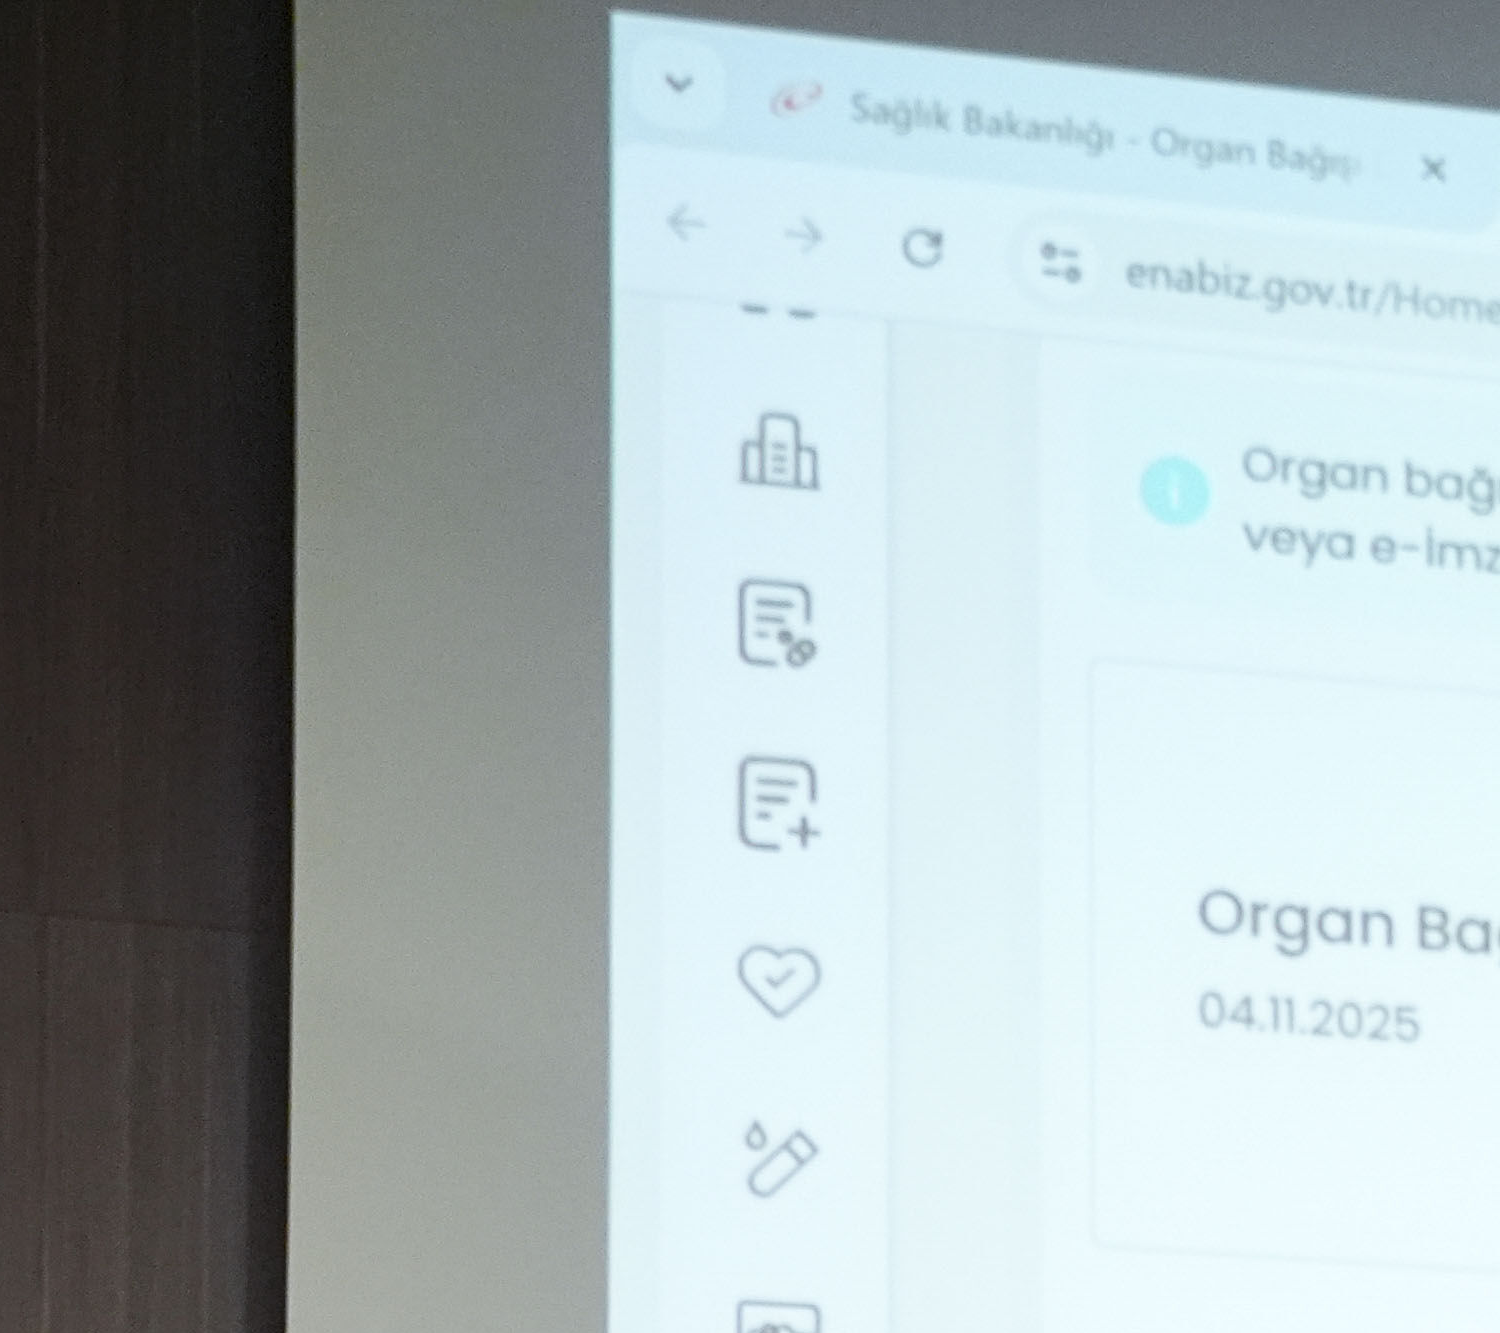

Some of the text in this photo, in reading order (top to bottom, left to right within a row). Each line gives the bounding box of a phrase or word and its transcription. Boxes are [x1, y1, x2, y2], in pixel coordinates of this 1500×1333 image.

[1151, 128, 1257, 170] Organ
[1241, 446, 1390, 500] Organ
[1241, 521, 1357, 569] veya
[1196, 886, 1396, 958] Organ
[1197, 990, 1423, 1045] 04.11.2025
